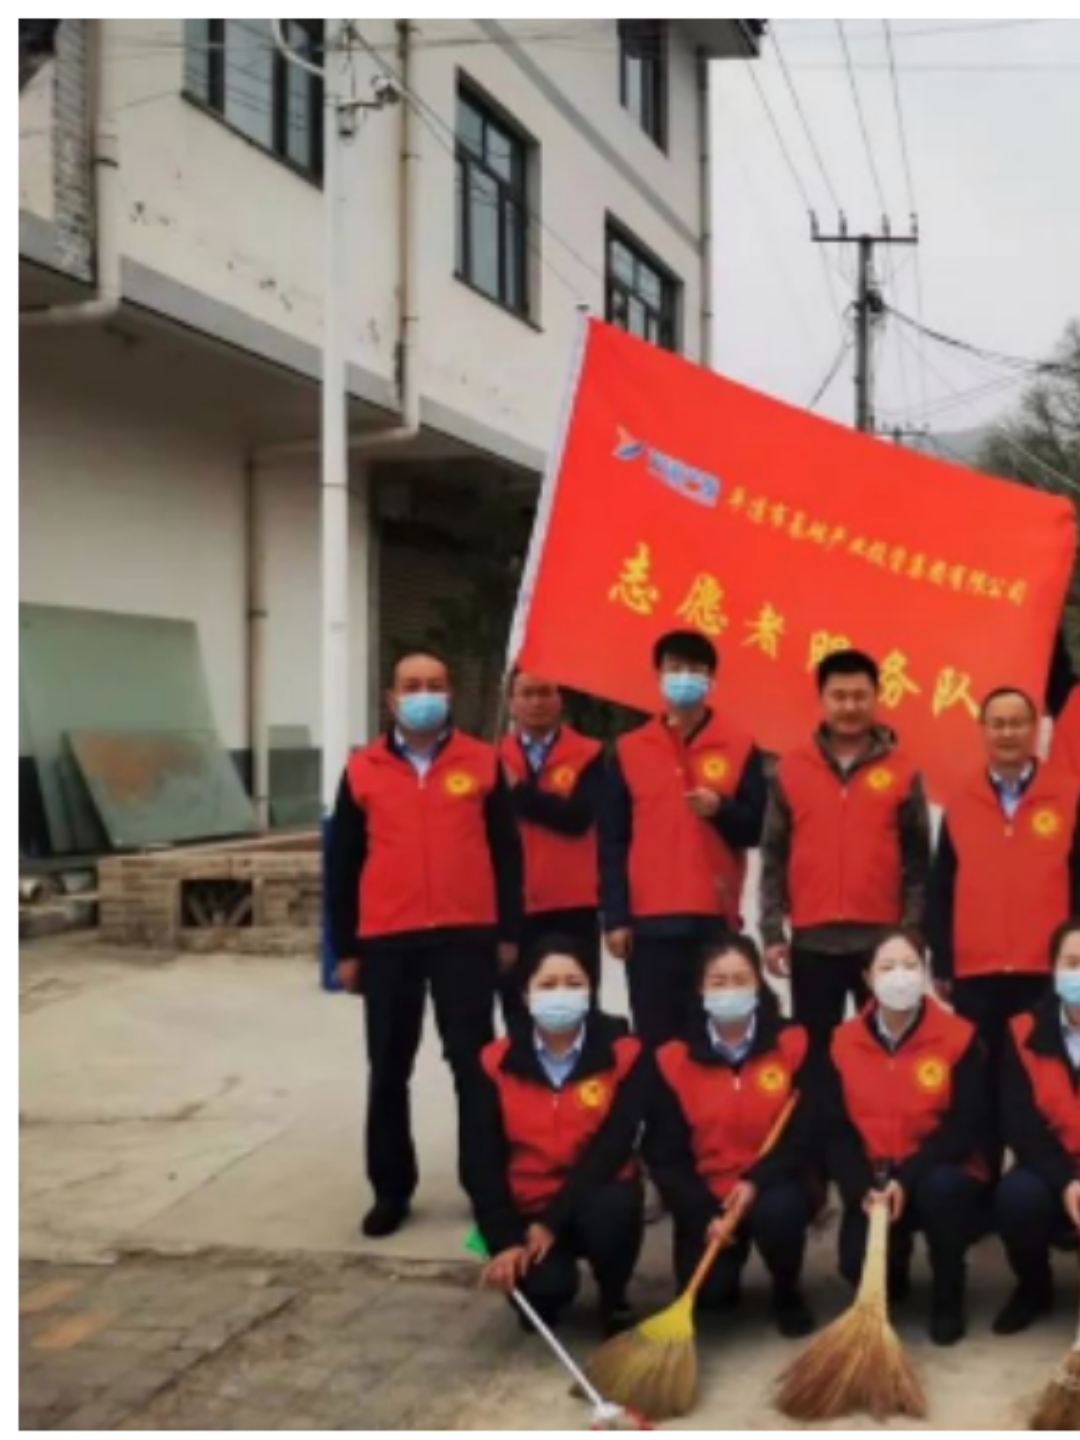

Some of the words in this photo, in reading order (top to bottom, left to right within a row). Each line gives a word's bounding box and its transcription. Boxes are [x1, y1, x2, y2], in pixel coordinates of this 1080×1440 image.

[608, 541, 981, 720] 志愿者服务队
